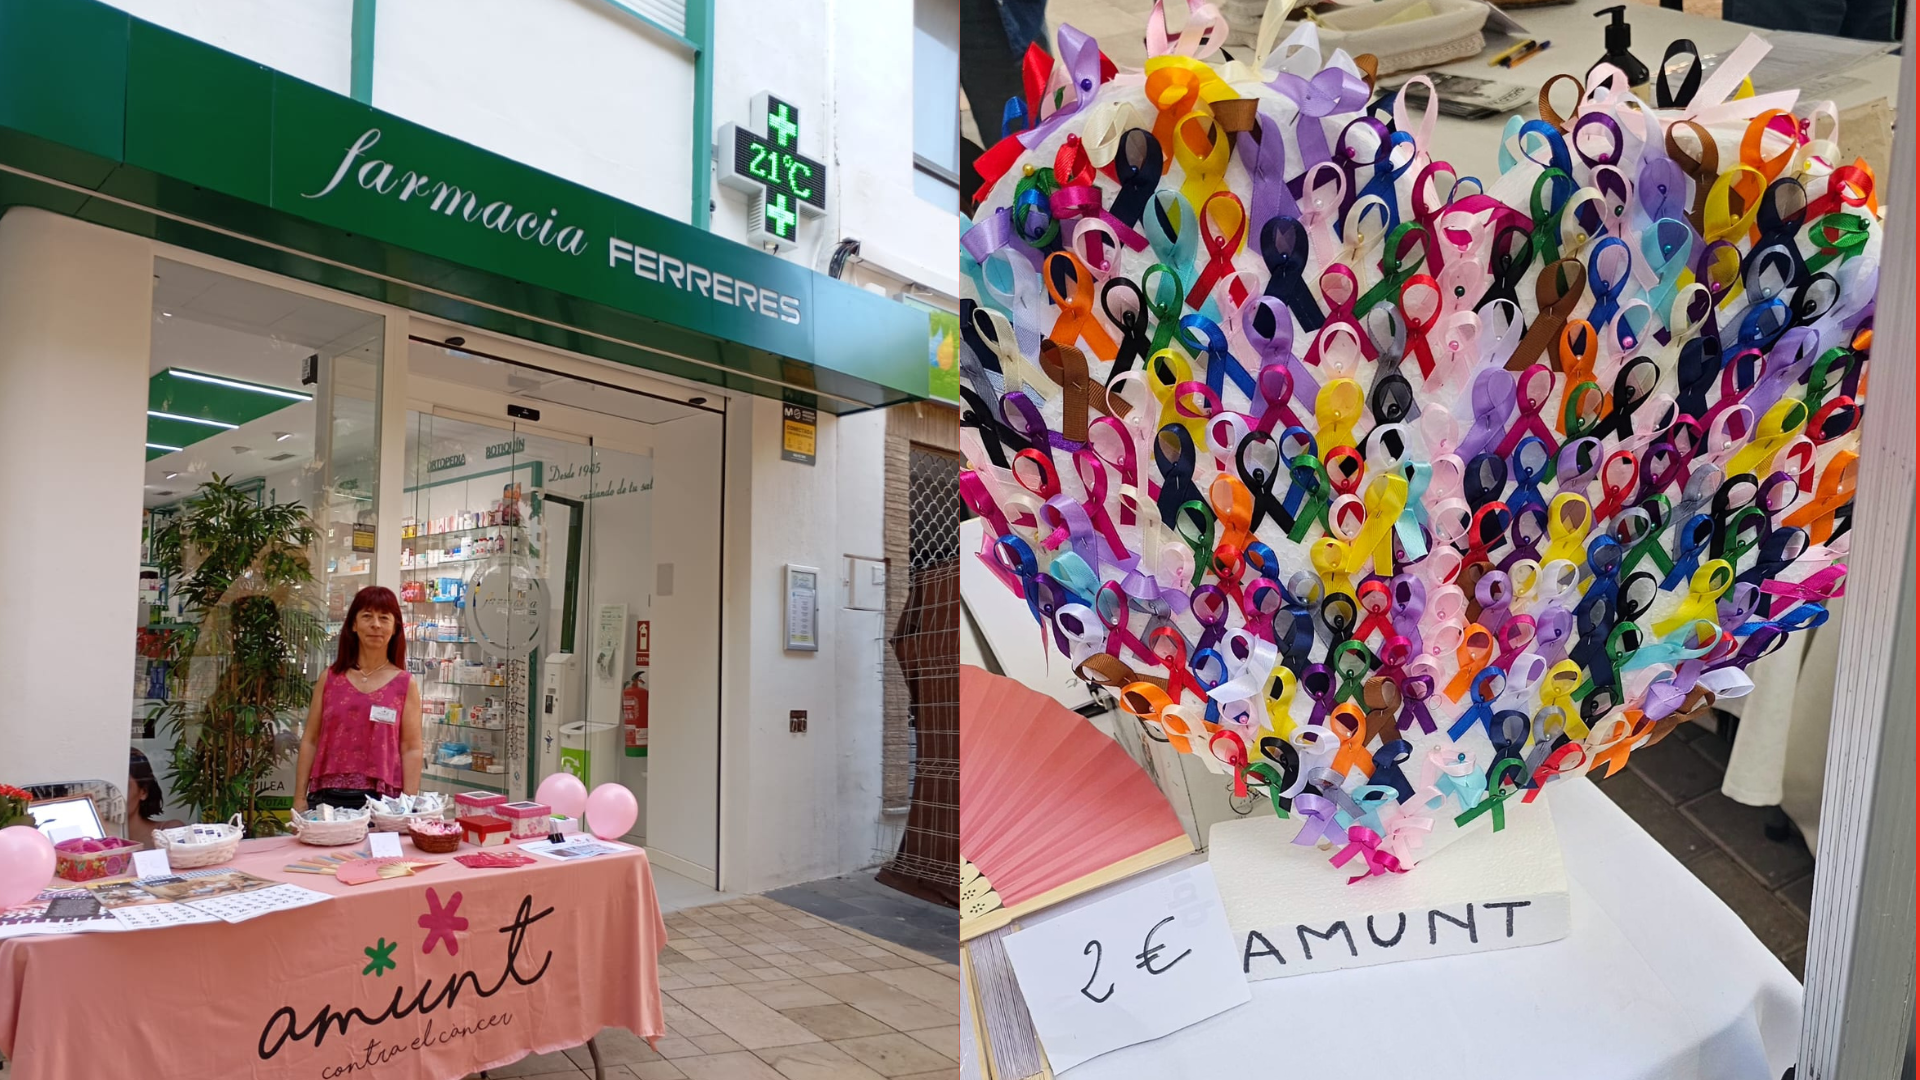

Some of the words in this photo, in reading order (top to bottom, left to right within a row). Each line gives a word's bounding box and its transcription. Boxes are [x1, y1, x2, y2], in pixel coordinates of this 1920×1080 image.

[750, 142, 812, 198] 21°C
[301, 128, 589, 257] farmacia
[609, 237, 801, 325] FERRERES
[427, 454, 466, 472] ORTOPEDIA
[548, 463, 574, 482] Desde
[617, 478, 626, 494] de
[629, 482, 638, 493] tu
[1080, 939, 1116, 1004] 2
[1135, 915, 1193, 976] €
[1243, 901, 1532, 973] AMUNT
[258, 894, 555, 1060] amunt
[321, 1039, 408, 1080] contra
[410, 1019, 436, 1050] el
